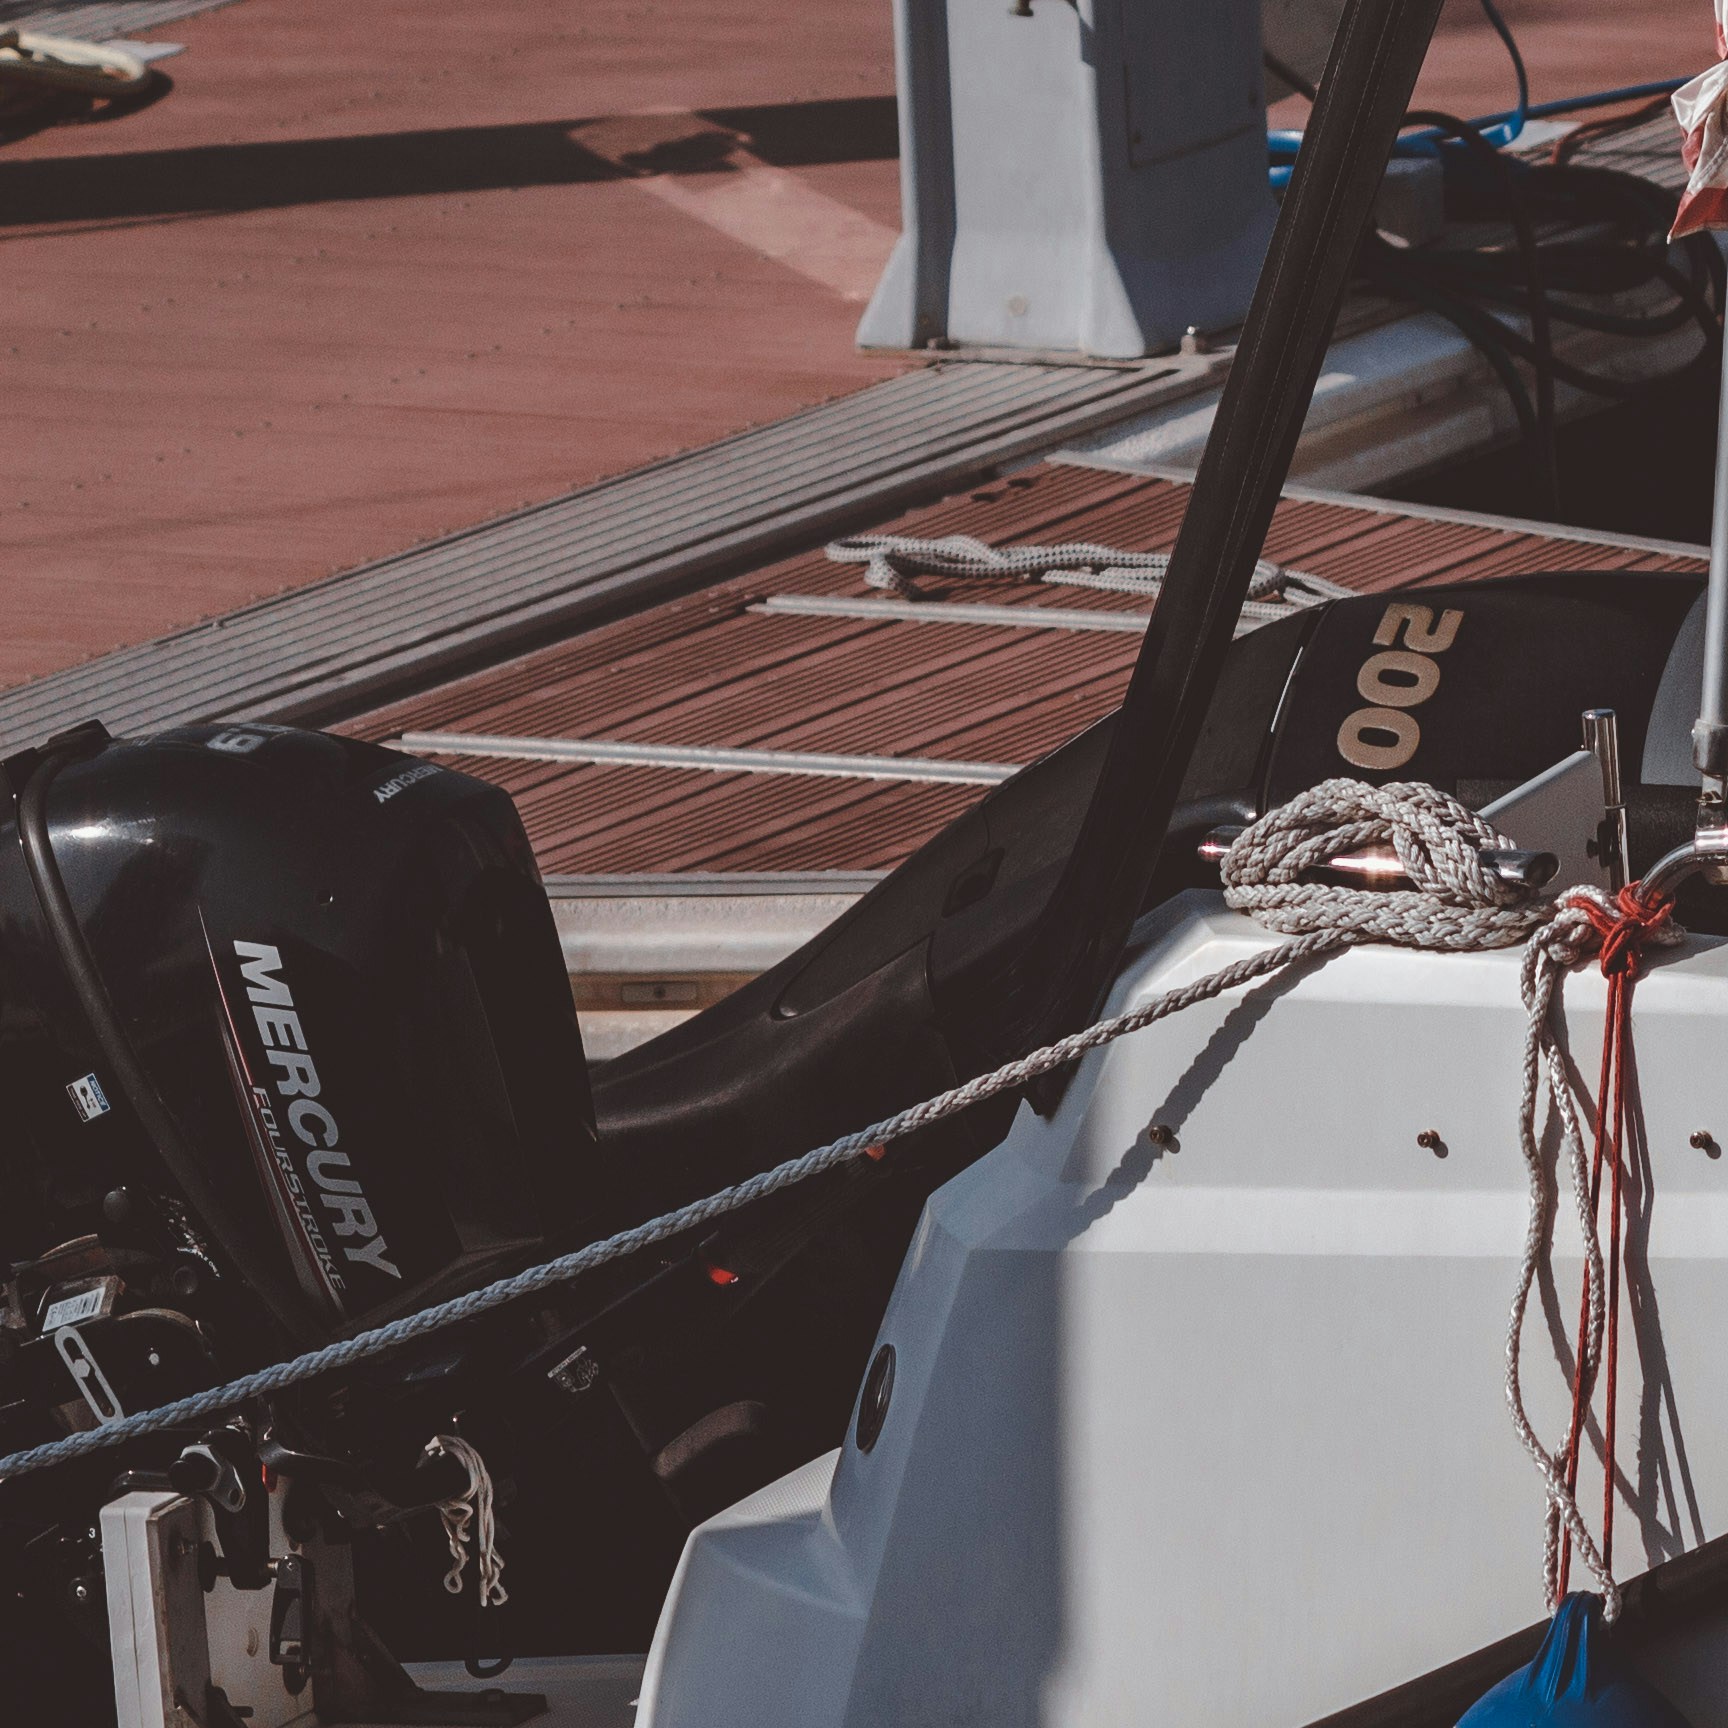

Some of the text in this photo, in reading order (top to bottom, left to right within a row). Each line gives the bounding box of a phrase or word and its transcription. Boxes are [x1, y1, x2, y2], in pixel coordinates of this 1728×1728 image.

[1336, 602, 1464, 770] 200
[372, 764, 445, 804] MERCURY
[233, 939, 402, 1279] MERCURY
[252, 1086, 346, 1290] FOURSTROKE
[88, 1527, 96, 1539] 3
